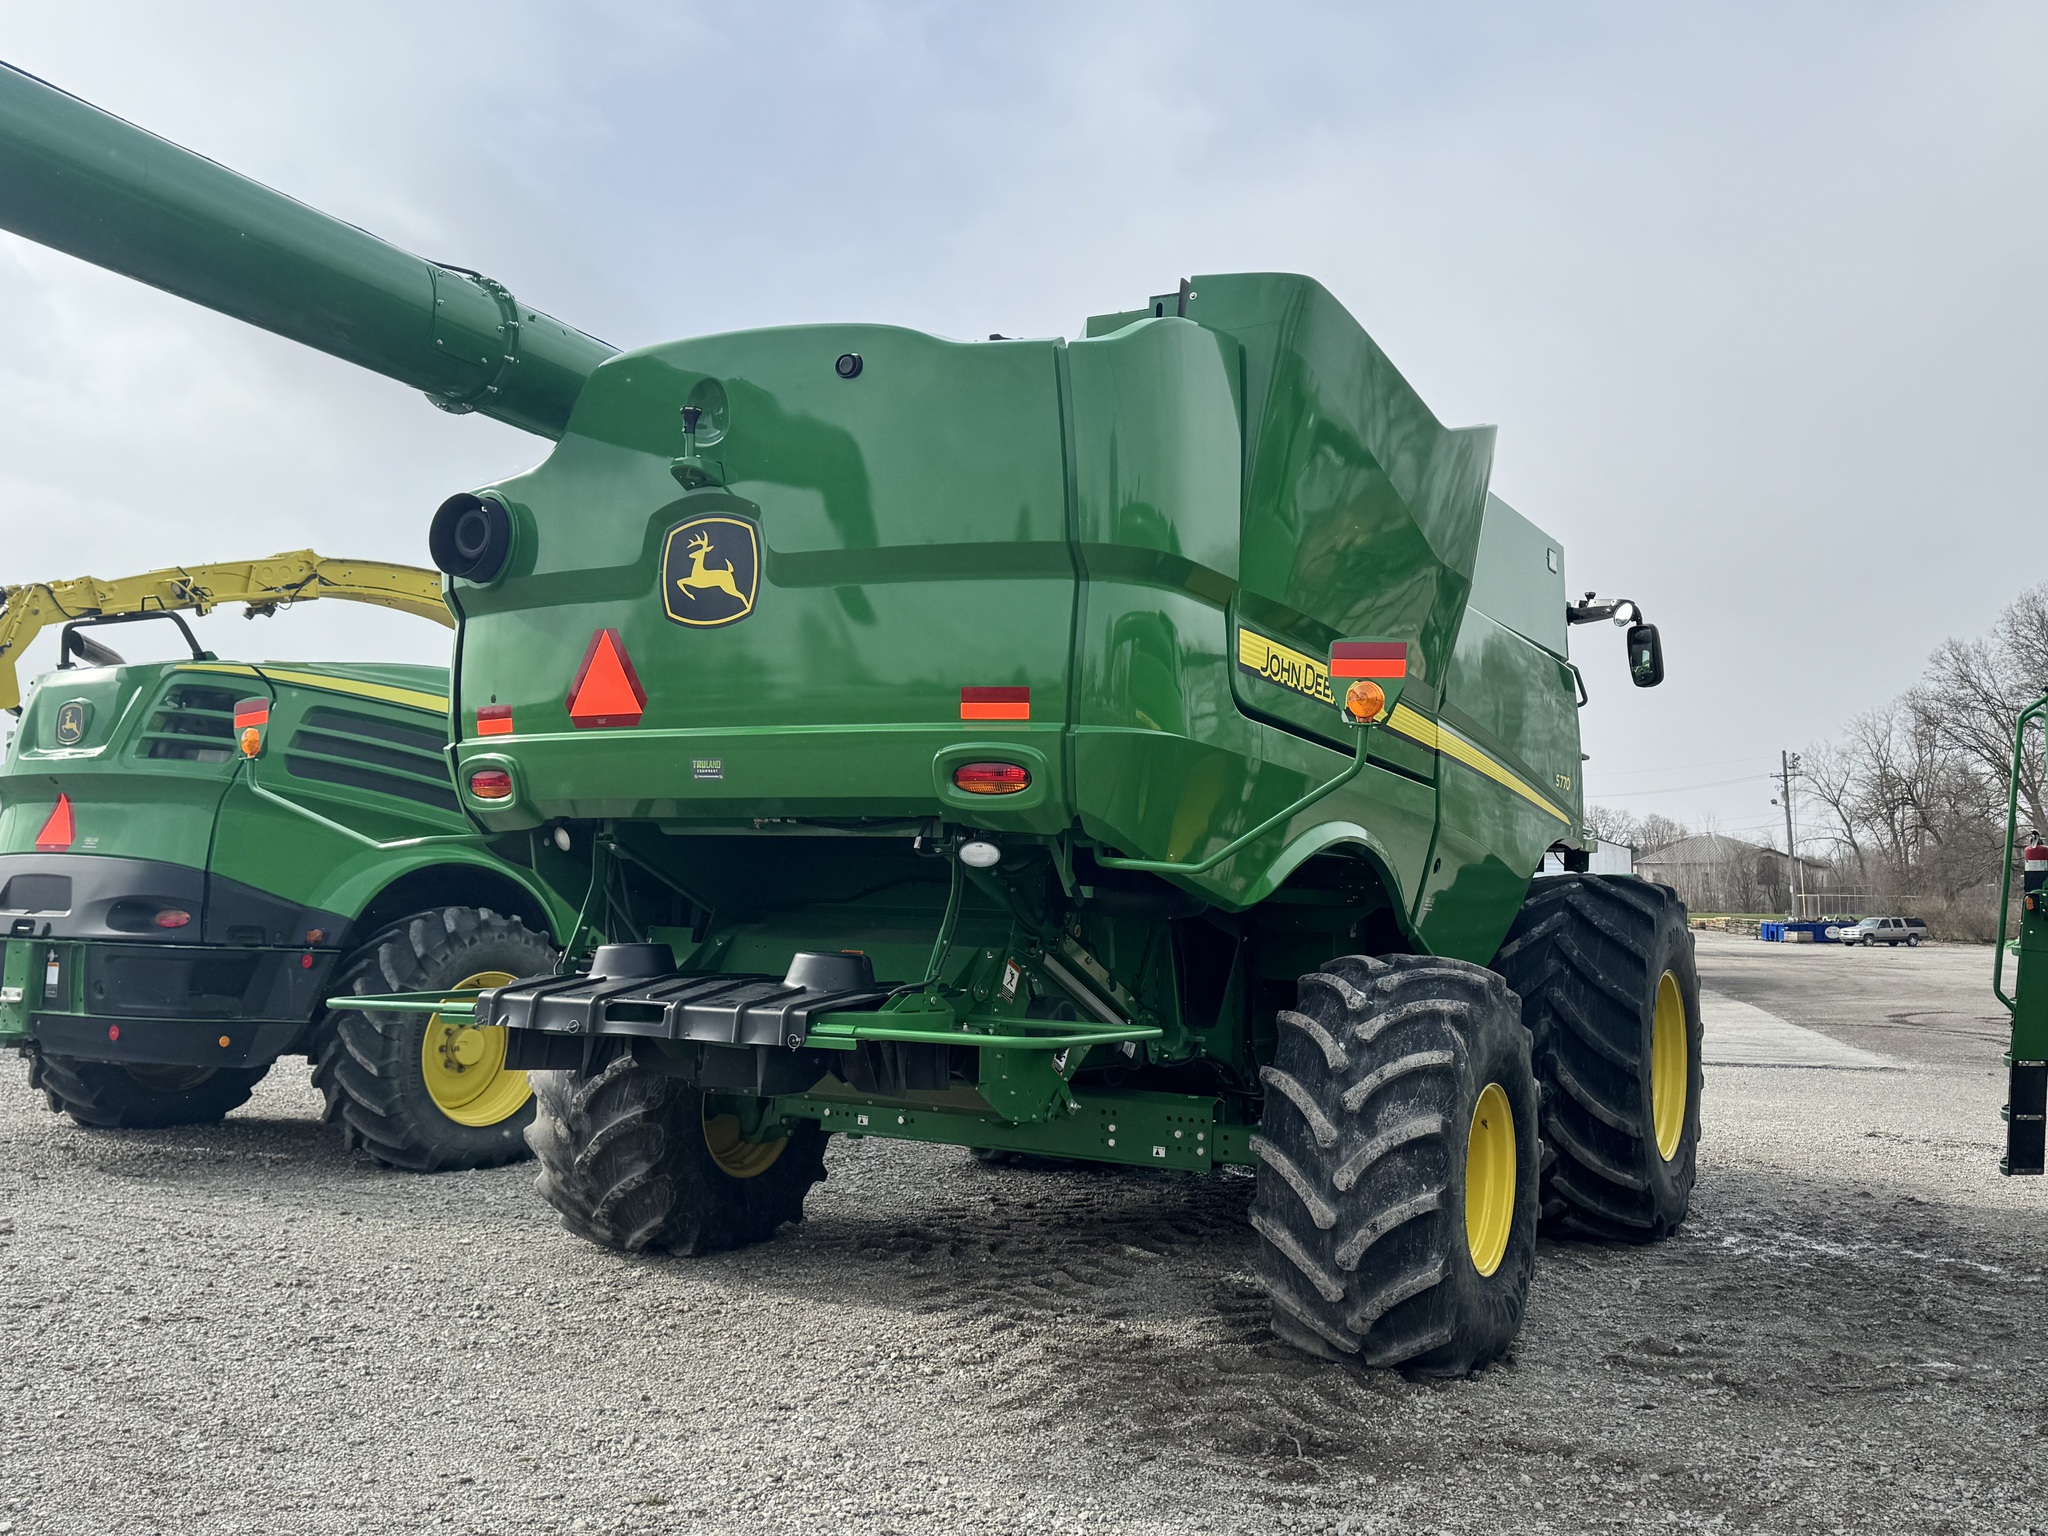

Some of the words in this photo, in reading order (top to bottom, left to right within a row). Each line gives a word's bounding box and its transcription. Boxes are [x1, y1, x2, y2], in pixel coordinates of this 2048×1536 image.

[1260, 646, 1302, 690] JOHN
[1304, 663, 1334, 701] DEE
[692, 760, 721, 768] TRULAND
[1556, 774, 1570, 790] S770
